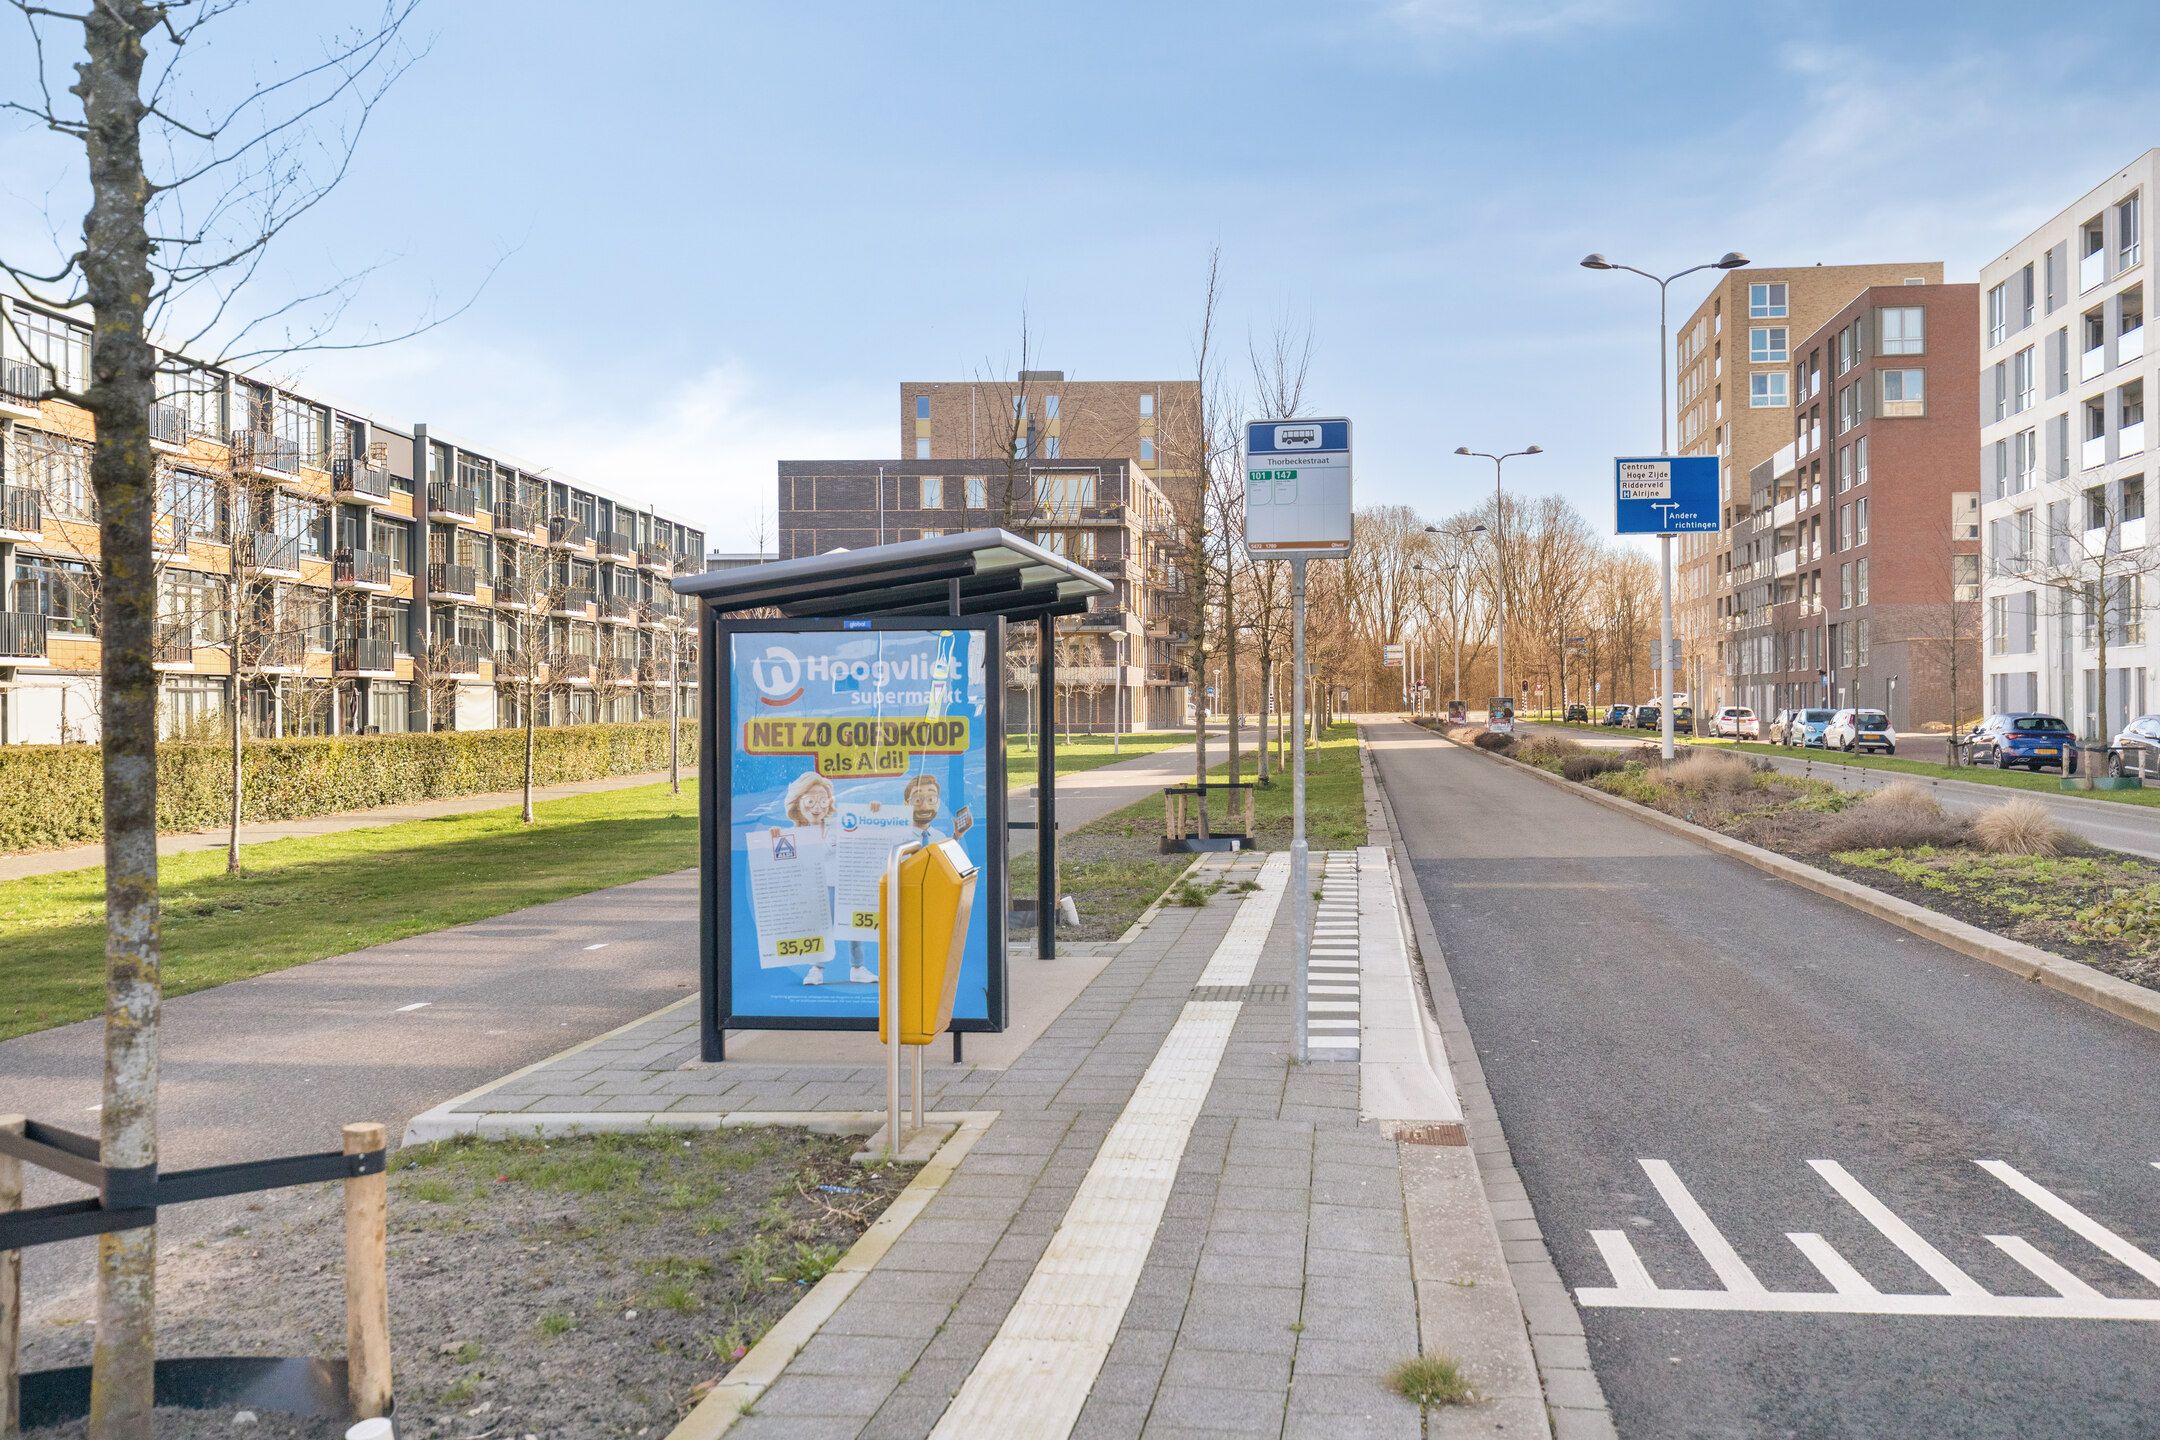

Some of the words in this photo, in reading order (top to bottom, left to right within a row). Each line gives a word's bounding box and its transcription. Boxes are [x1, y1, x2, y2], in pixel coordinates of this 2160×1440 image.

[1268, 457, 1330, 466] Thorbeckestraat
[1251, 472, 1266, 480] 101
[1276, 471, 1291, 479] 147
[1627, 472, 1646, 480] Hoge
[1648, 472, 1669, 480] Zijde
[1632, 490, 1660, 498] Alrijne
[1675, 522, 1717, 530] richtingen
[849, 621, 866, 629] global
[807, 653, 963, 687] Hoogvlit
[851, 688, 962, 708] supermakt
[753, 721, 797, 747] NET
[802, 721, 832, 747] ZO
[836, 721, 964, 747] GOEDKOOP
[824, 753, 853, 772] als
[857, 751, 904, 770] Aldi!
[859, 816, 909, 828] Hoogvliet
[779, 938, 821, 956] 35,97
